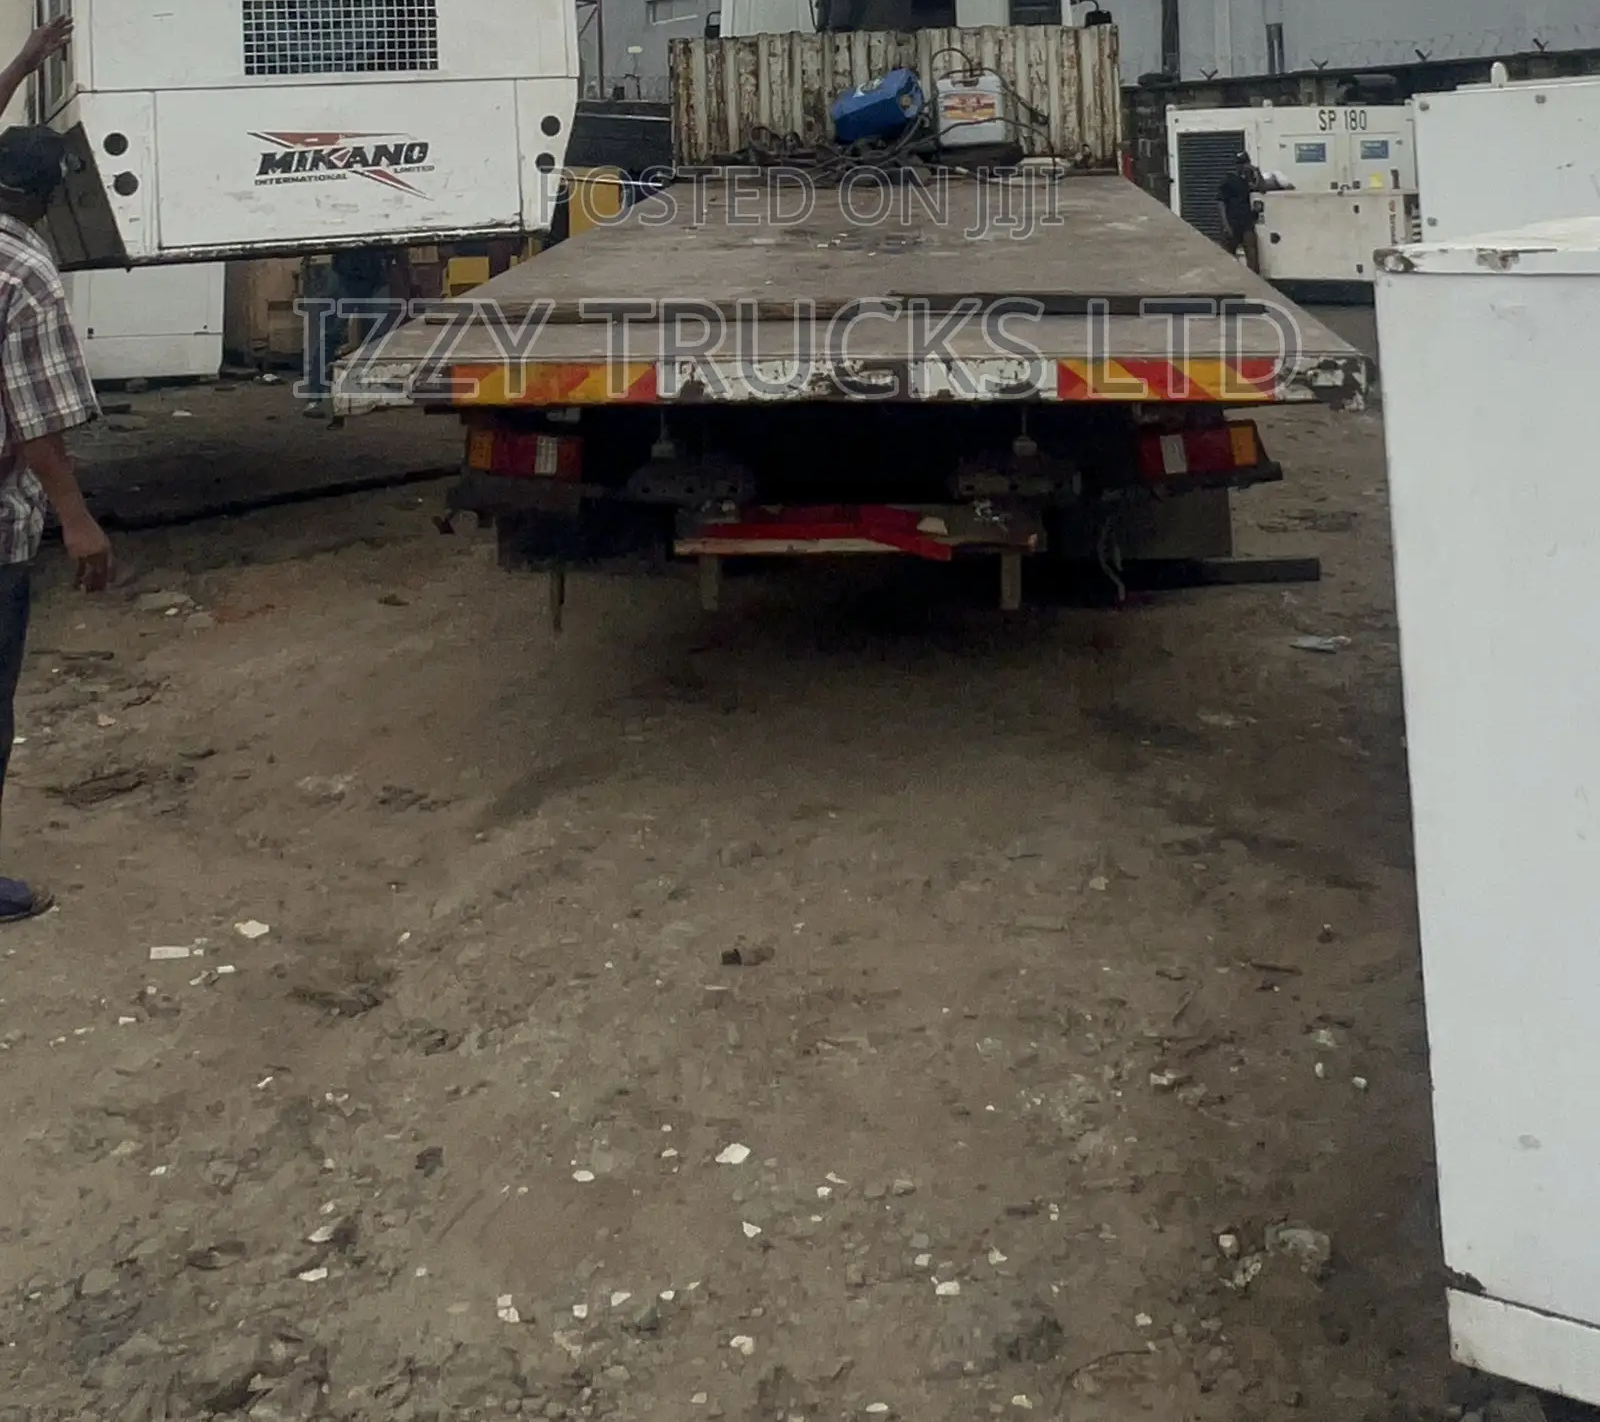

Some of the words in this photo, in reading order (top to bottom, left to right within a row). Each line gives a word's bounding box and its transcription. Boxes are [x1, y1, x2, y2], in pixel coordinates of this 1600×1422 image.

[1318, 109, 1337, 131] SP
[1344, 109, 1368, 131] 180
[255, 141, 429, 176] MIKANO
[393, 164, 435, 174] LIMITED
[254, 172, 348, 186] INTERNATIONAL
